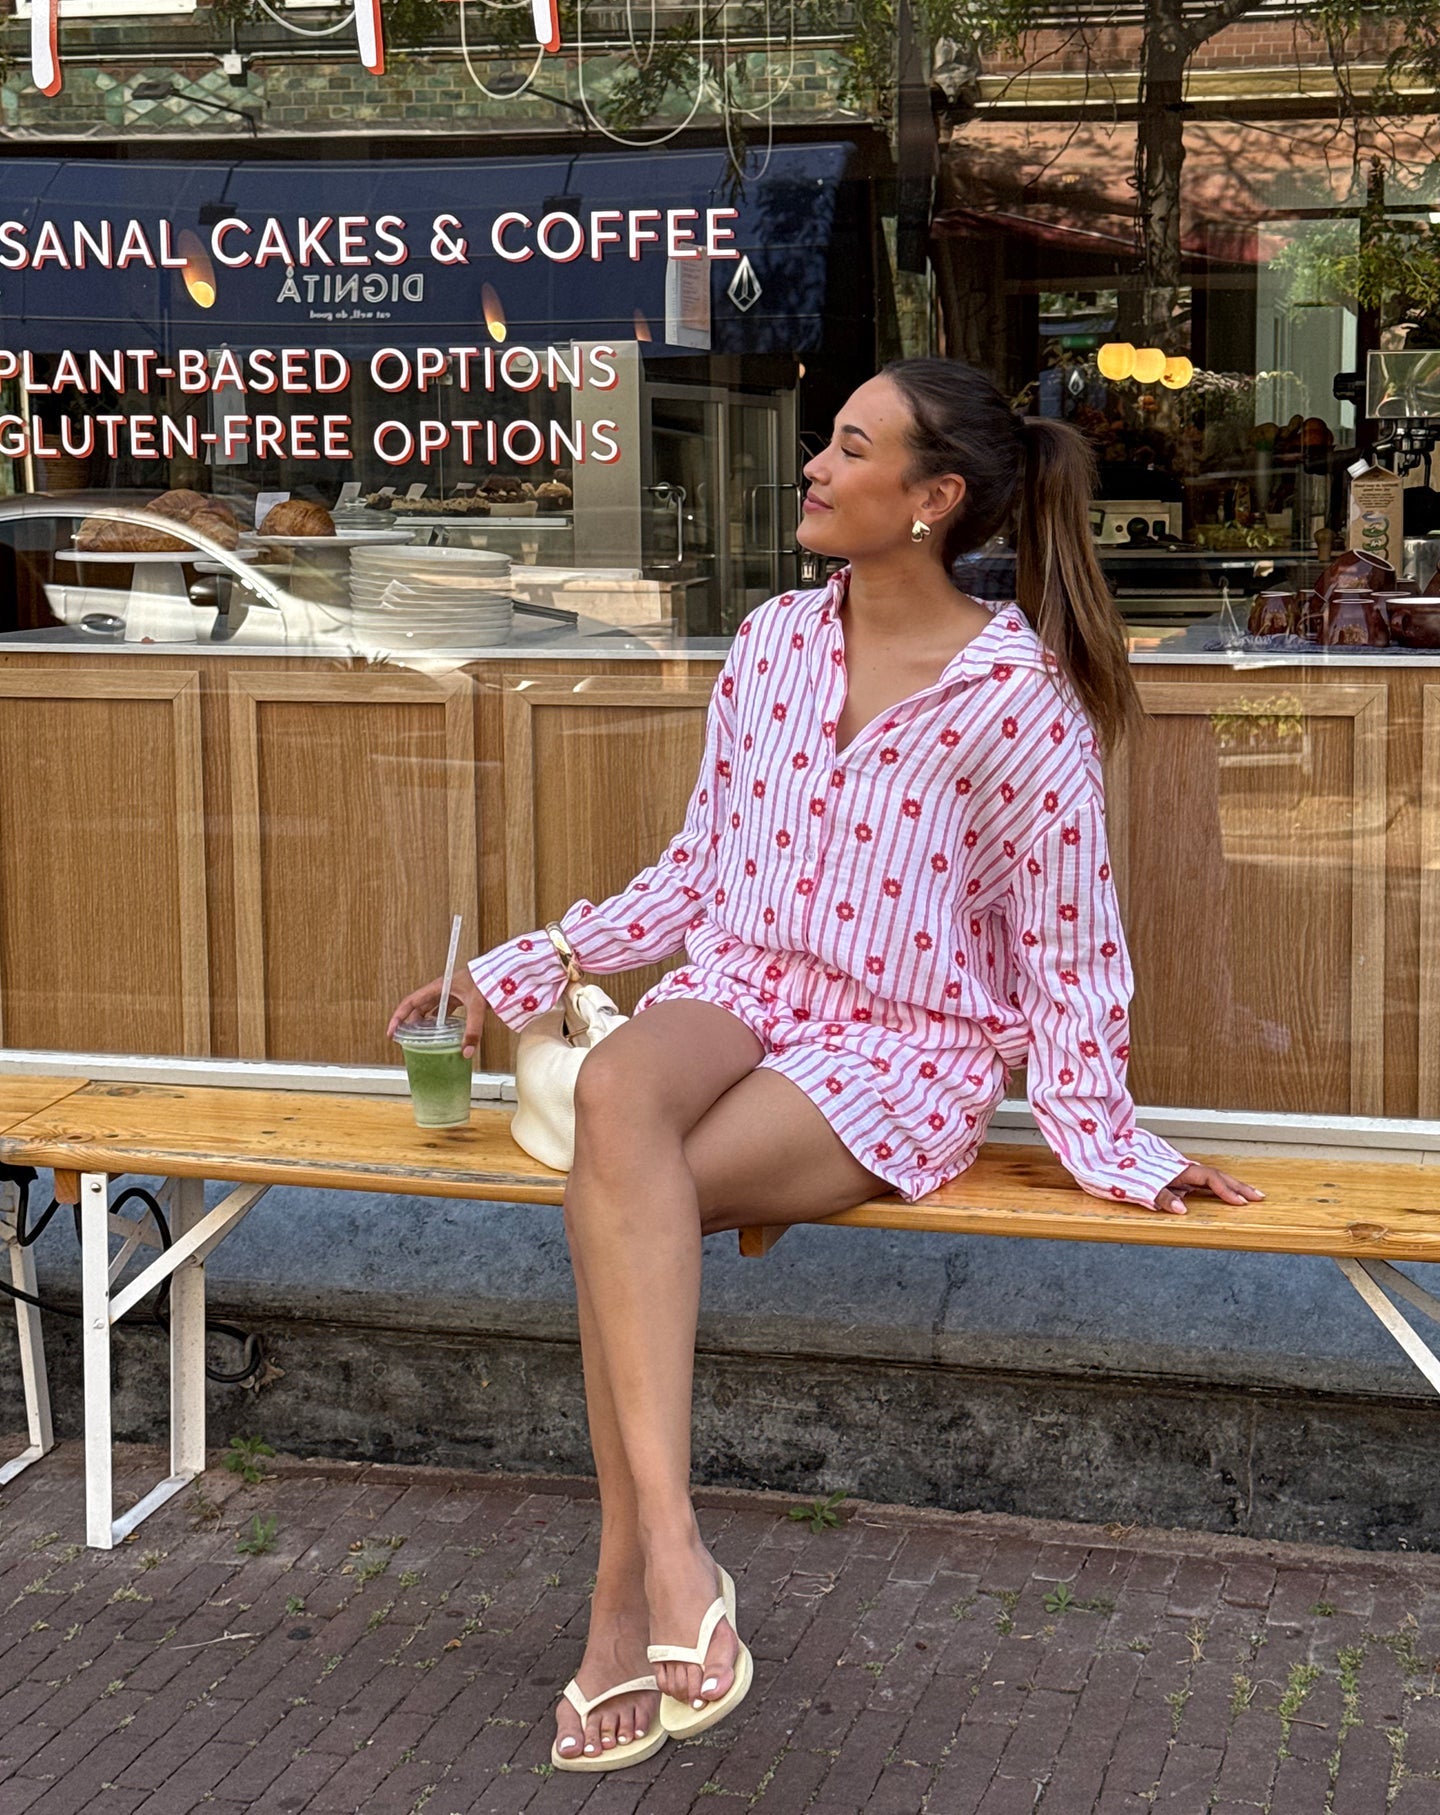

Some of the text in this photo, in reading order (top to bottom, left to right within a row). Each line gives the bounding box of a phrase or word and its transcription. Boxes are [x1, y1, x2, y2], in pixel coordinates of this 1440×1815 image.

[0, 208, 740, 270] SANAL CAKES & COFFEE
[370, 346, 620, 392] OPTIONS
[0, 414, 622, 466] GLUTEN-FREE OPTIONS
